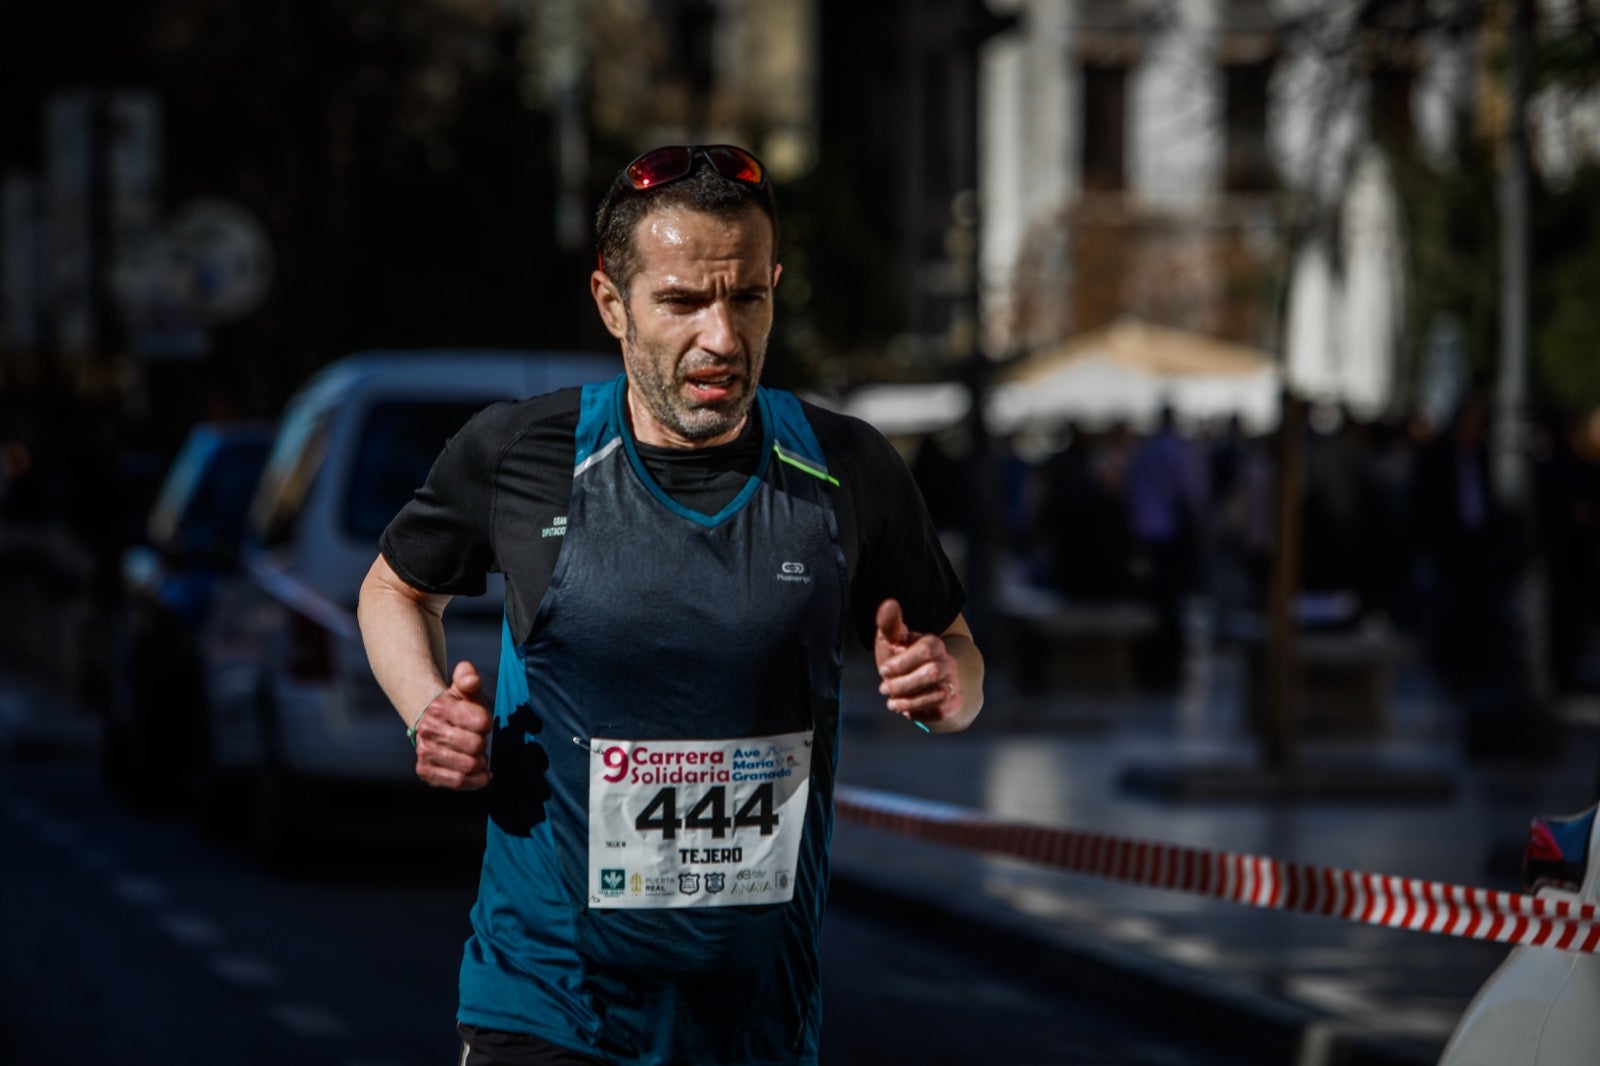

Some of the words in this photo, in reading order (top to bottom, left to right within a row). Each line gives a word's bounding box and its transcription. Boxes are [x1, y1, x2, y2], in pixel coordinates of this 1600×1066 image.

[733, 748, 760, 758] Ave
[603, 746, 629, 783] 9
[631, 746, 724, 765] Carrera
[631, 766, 730, 784] Solidaria
[732, 768, 792, 781] Granada
[635, 782, 779, 840] 444
[679, 847, 742, 864] TEJERO
